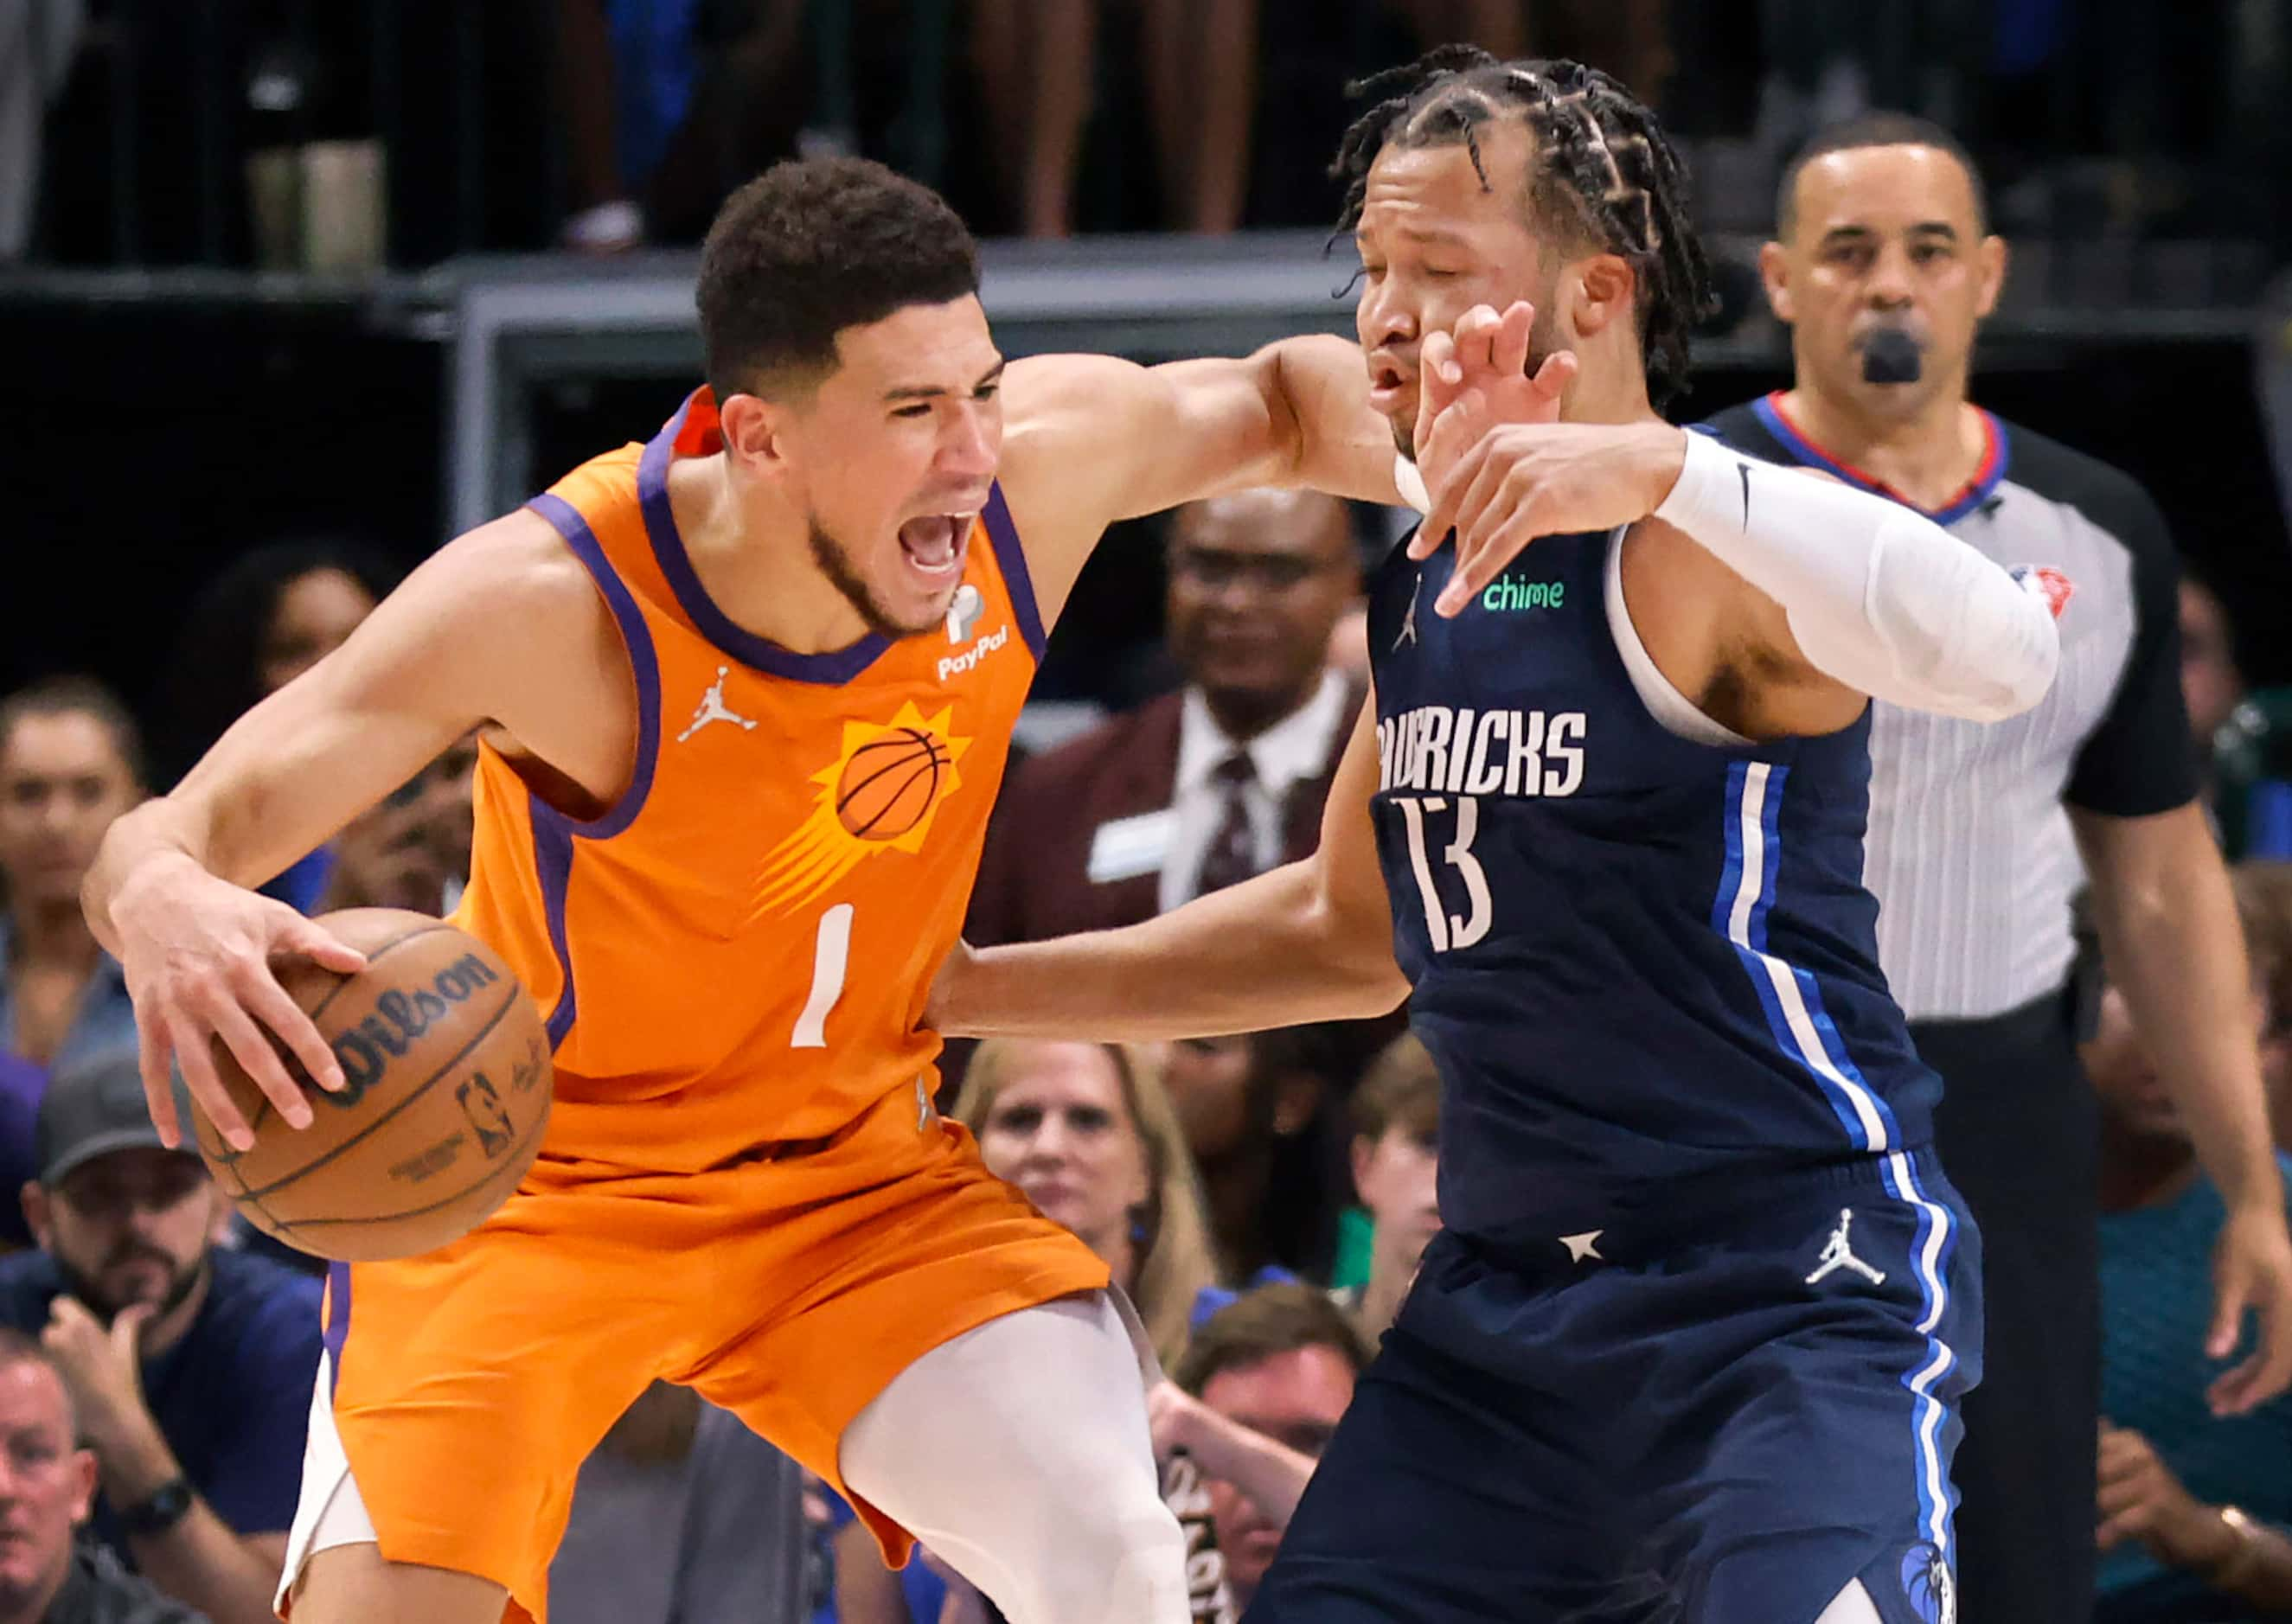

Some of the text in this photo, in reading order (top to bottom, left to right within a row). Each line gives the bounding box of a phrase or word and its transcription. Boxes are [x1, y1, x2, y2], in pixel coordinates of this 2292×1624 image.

[1483, 573, 1564, 611] chime
[938, 624, 1008, 681] PayPal
[1389, 796, 1492, 953] 13
[791, 903, 855, 1048] 1
